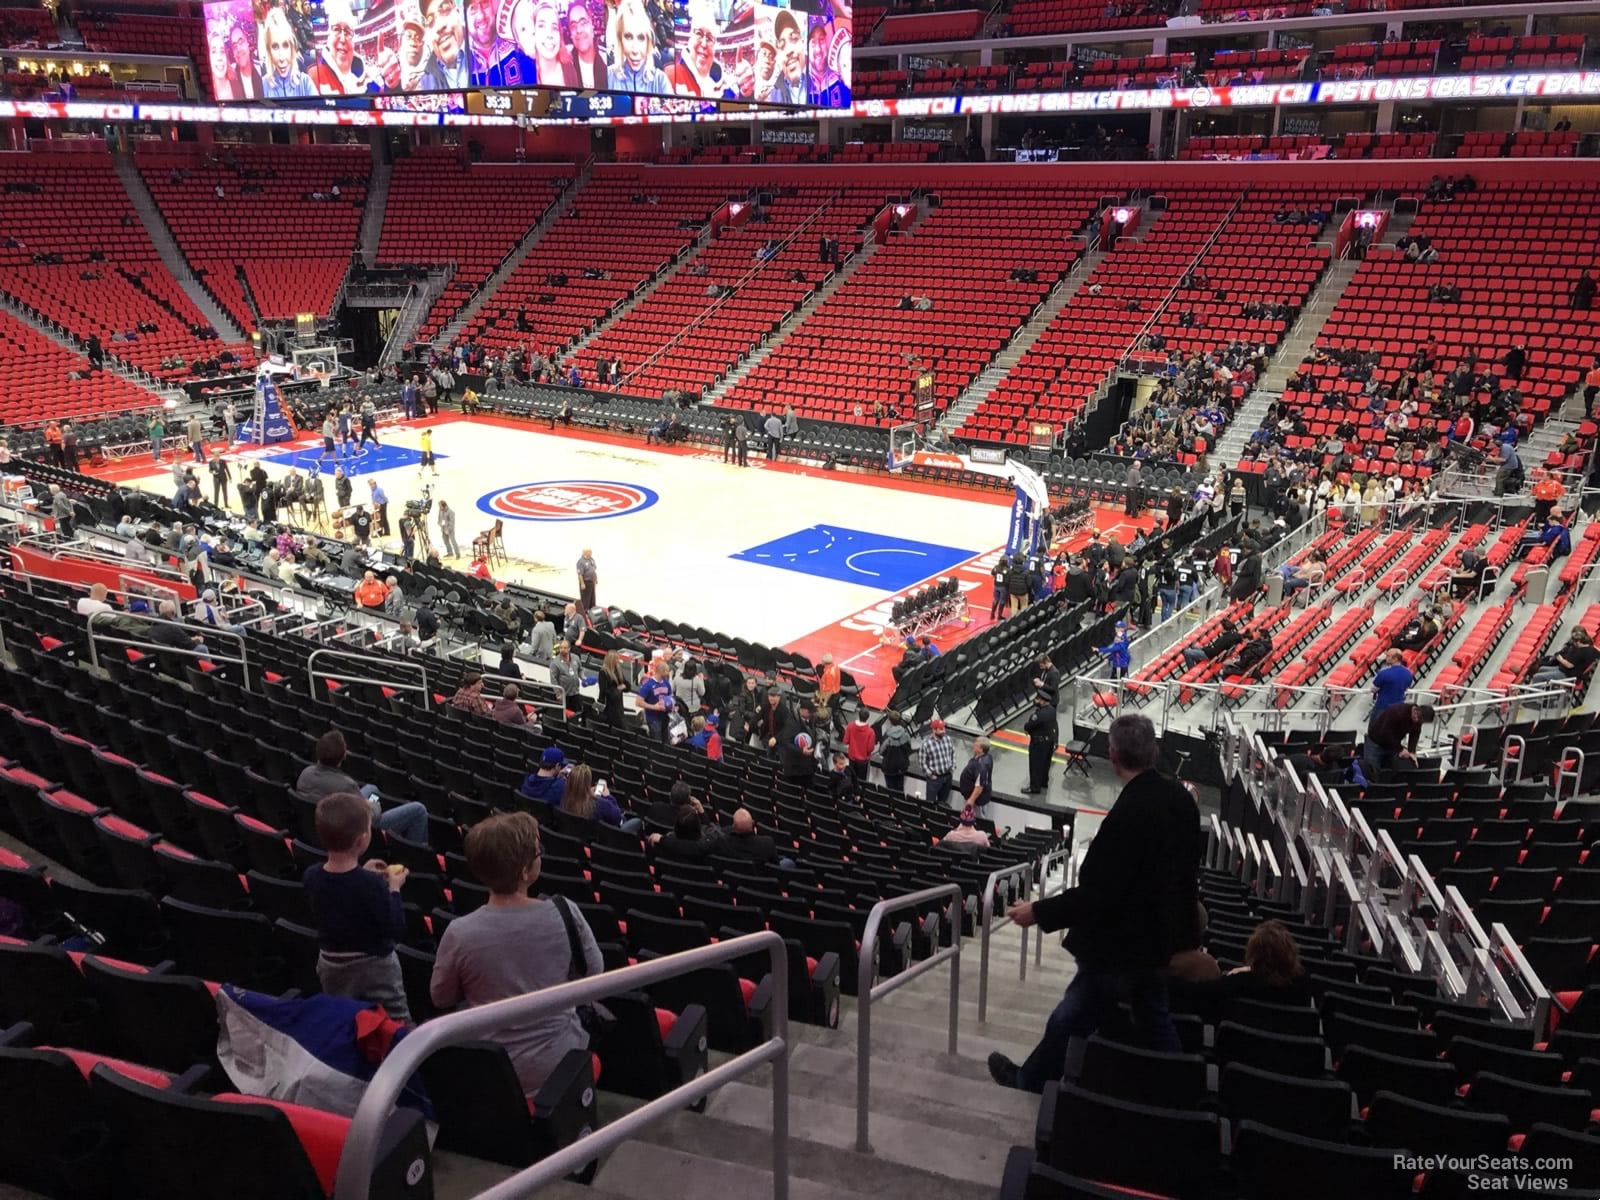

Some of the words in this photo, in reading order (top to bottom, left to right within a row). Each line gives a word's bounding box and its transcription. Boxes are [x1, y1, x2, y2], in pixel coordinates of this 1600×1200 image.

[896, 97, 955, 115] WATCH
[961, 94, 1041, 113] PISTONS
[1042, 89, 1172, 111] BASKETBALL
[1232, 83, 1310, 105] WATCH
[1317, 78, 1429, 102] PISTONS
[66, 103, 132, 118] WATCH
[139, 105, 219, 121] PISTONS
[221, 107, 338, 124] BASKETBALL
